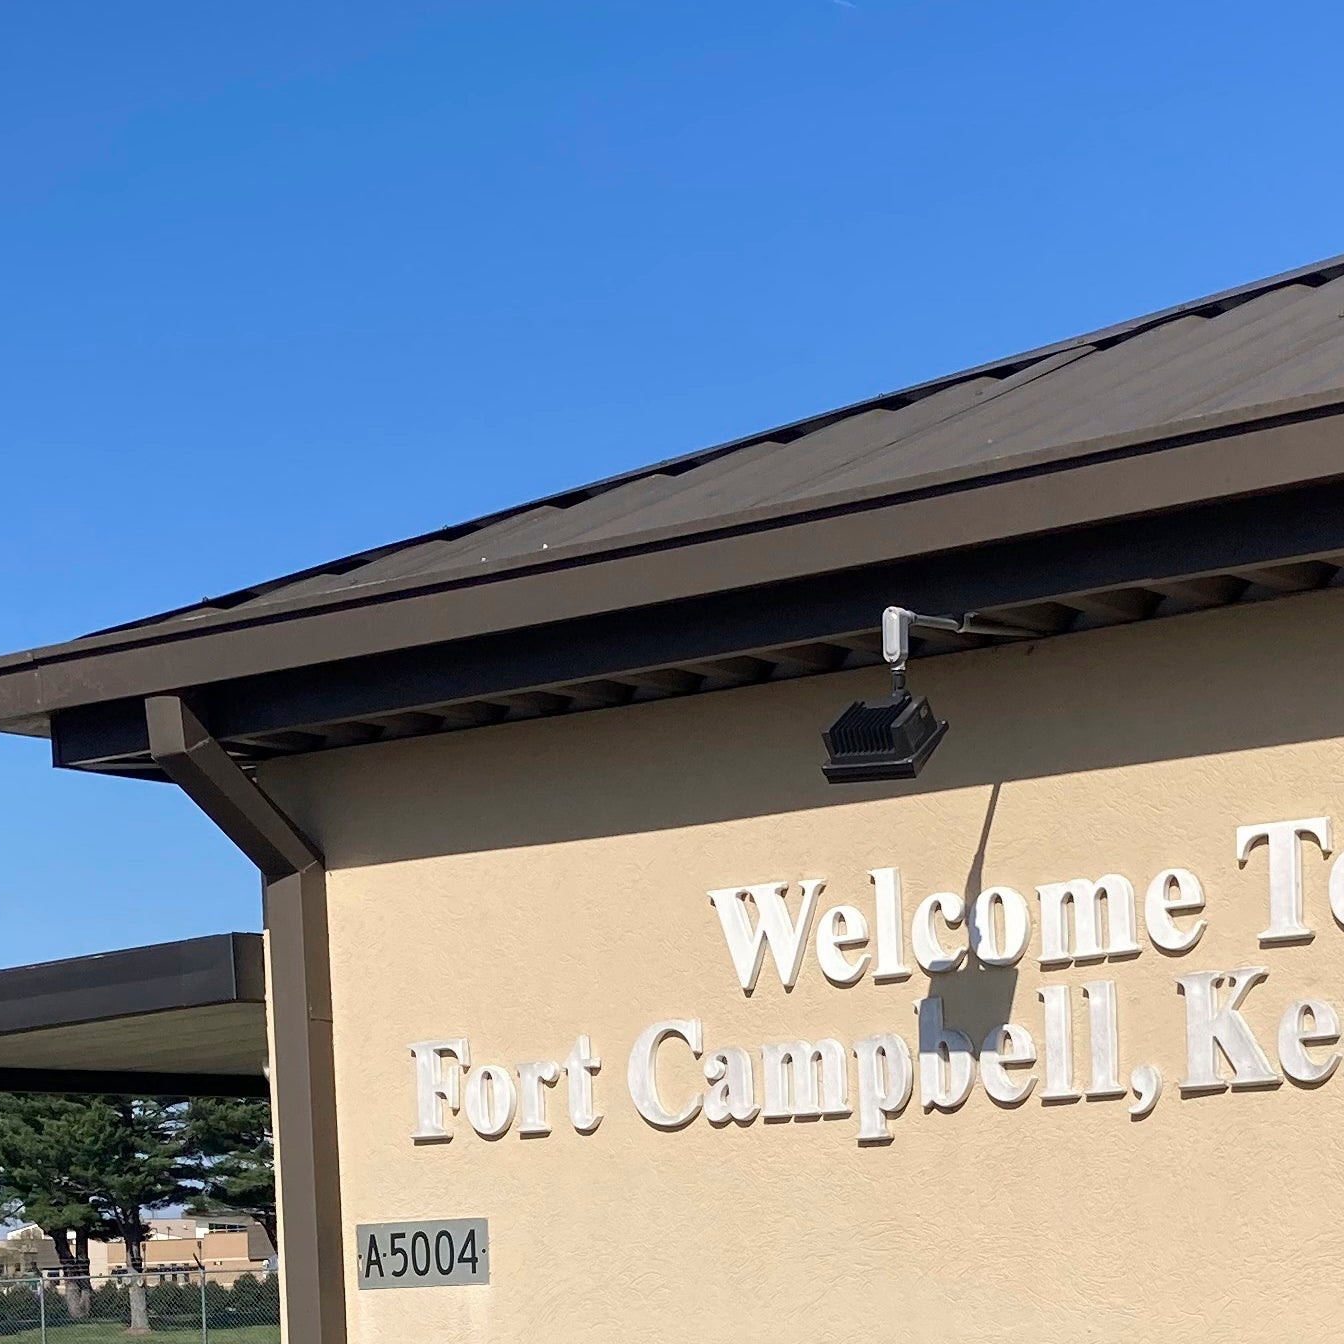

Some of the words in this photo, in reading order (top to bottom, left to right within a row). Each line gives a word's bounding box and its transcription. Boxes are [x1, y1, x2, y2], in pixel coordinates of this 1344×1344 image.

[708, 866, 1207, 992] Welcome
[408, 1035, 602, 1142] Fort
[628, 980, 1160, 1145] Campbell,
[364, 1229, 478, 1278] A5004
